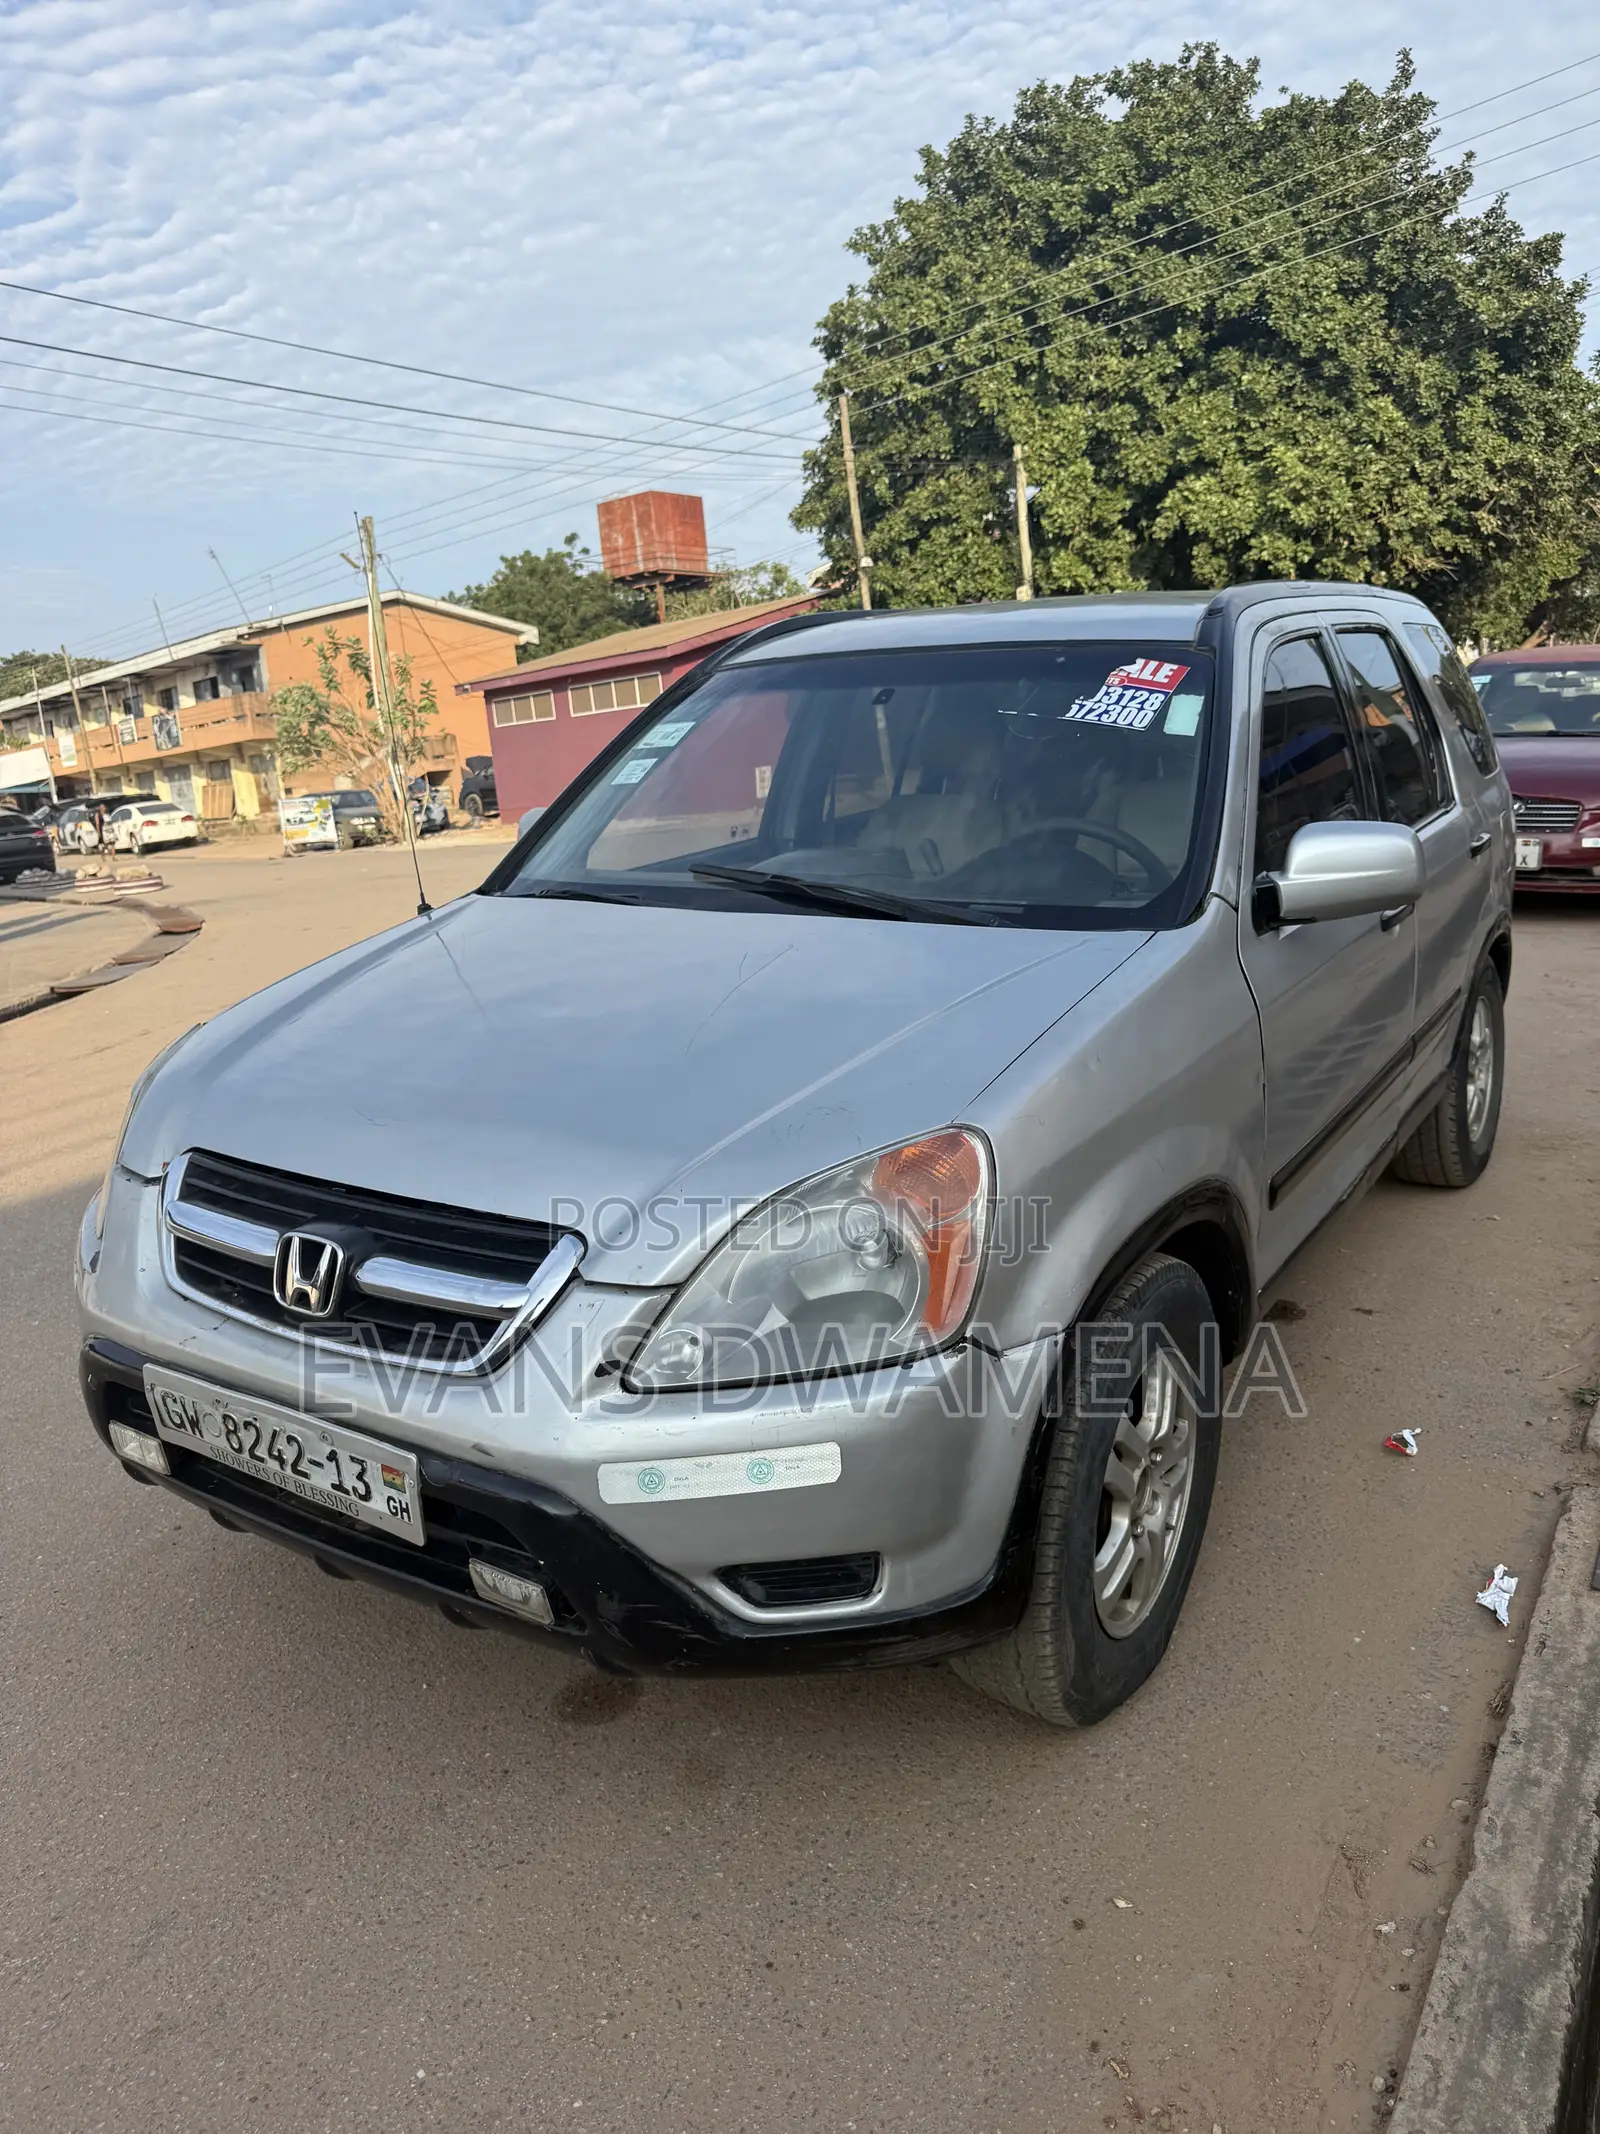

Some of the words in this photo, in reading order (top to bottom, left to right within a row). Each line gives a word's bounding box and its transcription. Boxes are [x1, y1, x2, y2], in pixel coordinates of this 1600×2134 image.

[160, 1389, 204, 1440] GW
[222, 1411, 374, 1503] 8242-13
[209, 1445, 271, 1481] SHOWERS
[272, 1471, 291, 1487] OF
[295, 1479, 360, 1518] BLESSING
[385, 1494, 413, 1524] GH
